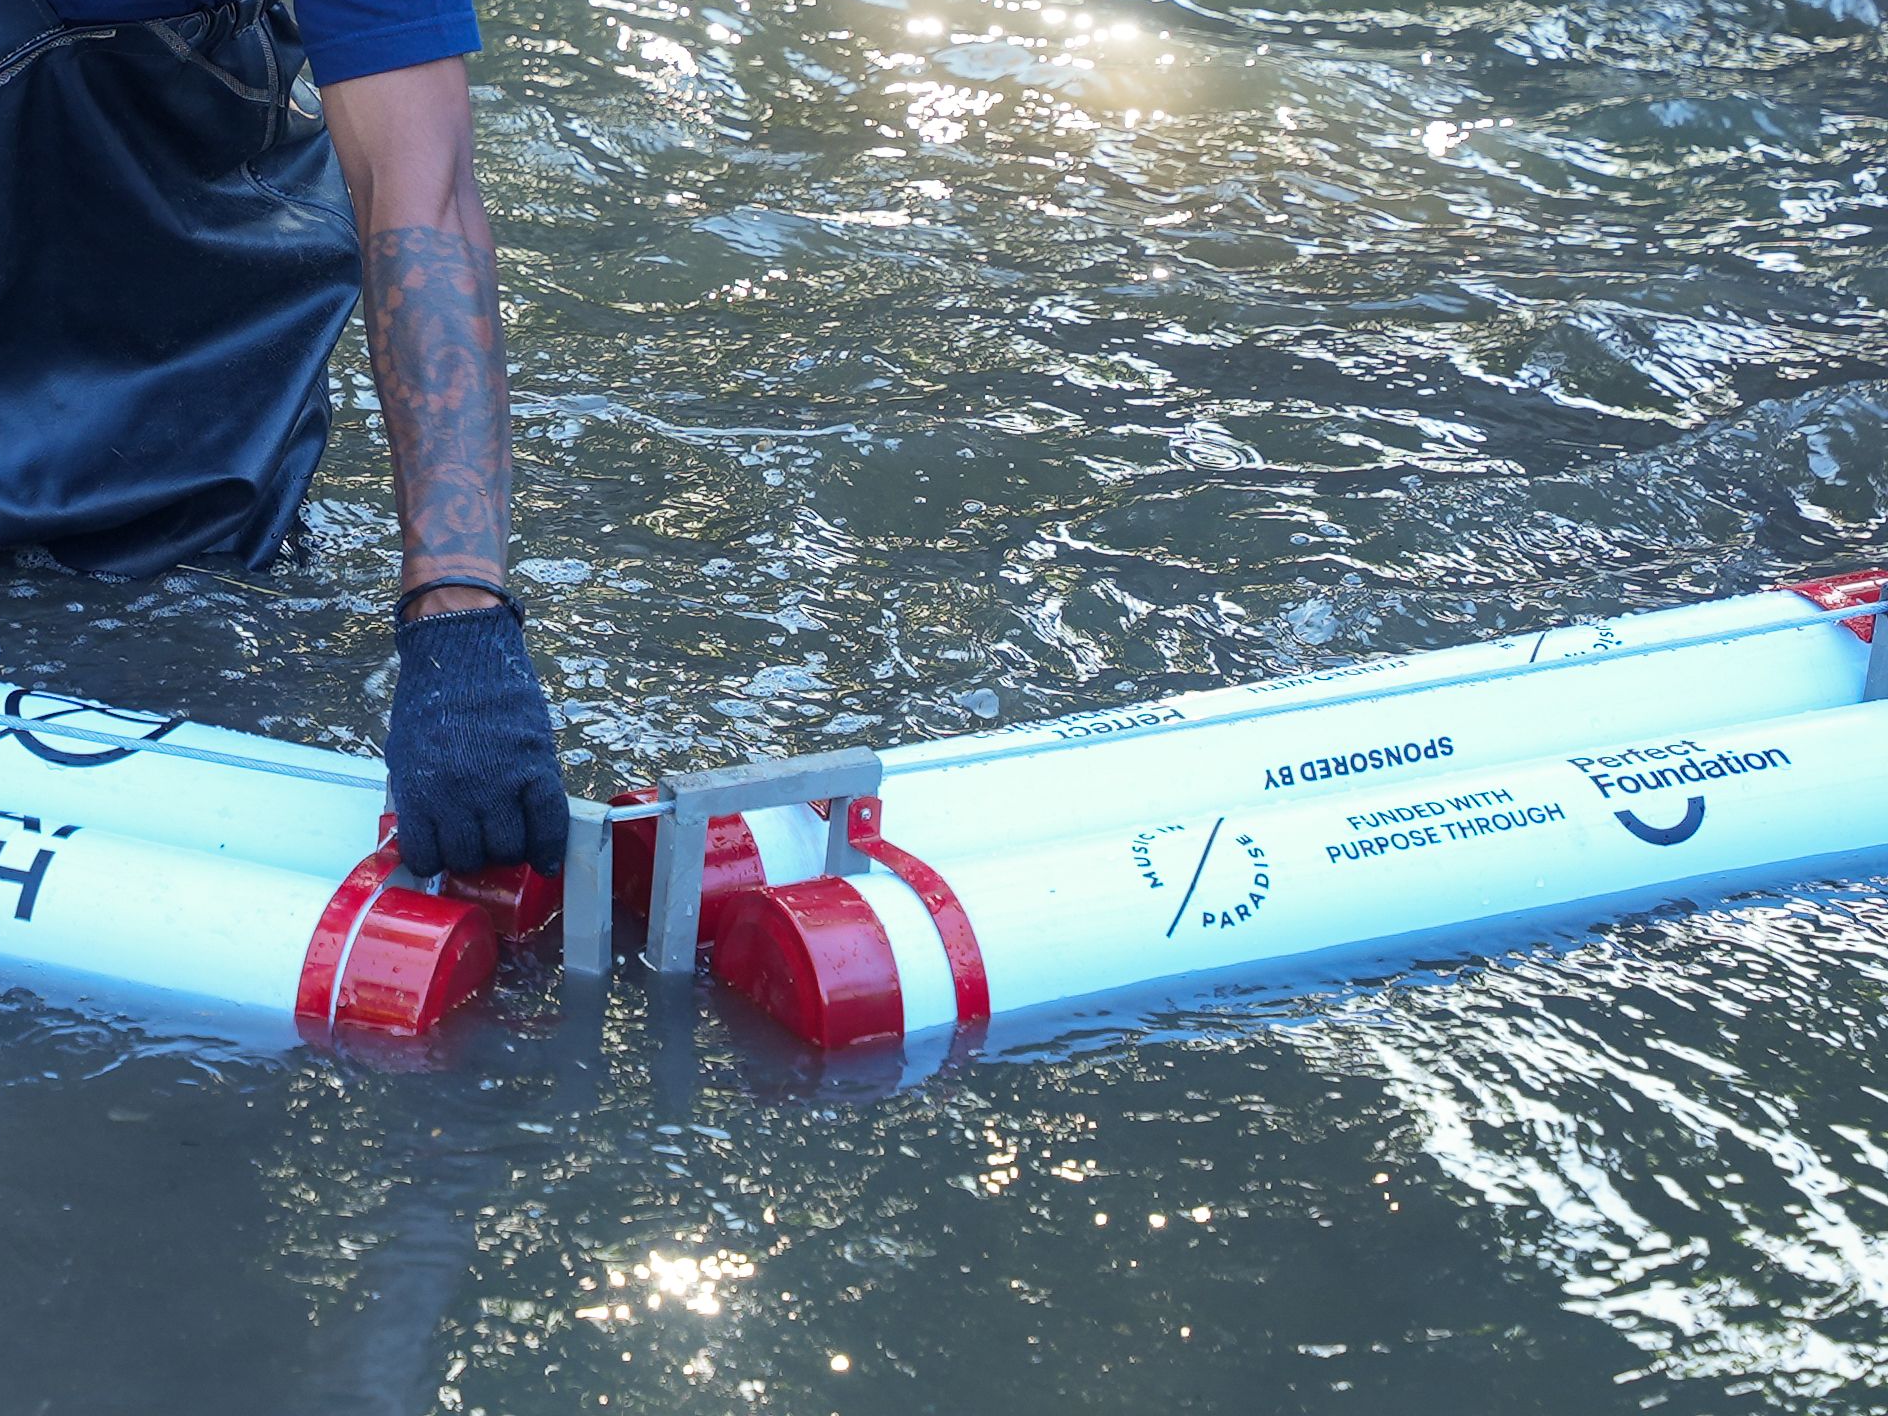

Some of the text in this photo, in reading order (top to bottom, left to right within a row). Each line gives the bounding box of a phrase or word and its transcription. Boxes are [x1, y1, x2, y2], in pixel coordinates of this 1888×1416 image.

[1264, 736, 1454, 790] SPONSORED BY
[1567, 740, 1707, 773] Perfect
[1588, 747, 1792, 799] Foundation
[1325, 802, 1566, 864] PURPOSE THROUGH
[1346, 788, 1514, 830] FUNDED WITH
[1132, 833, 1164, 889] MUSIC
[1202, 833, 1270, 929] PARADISE
